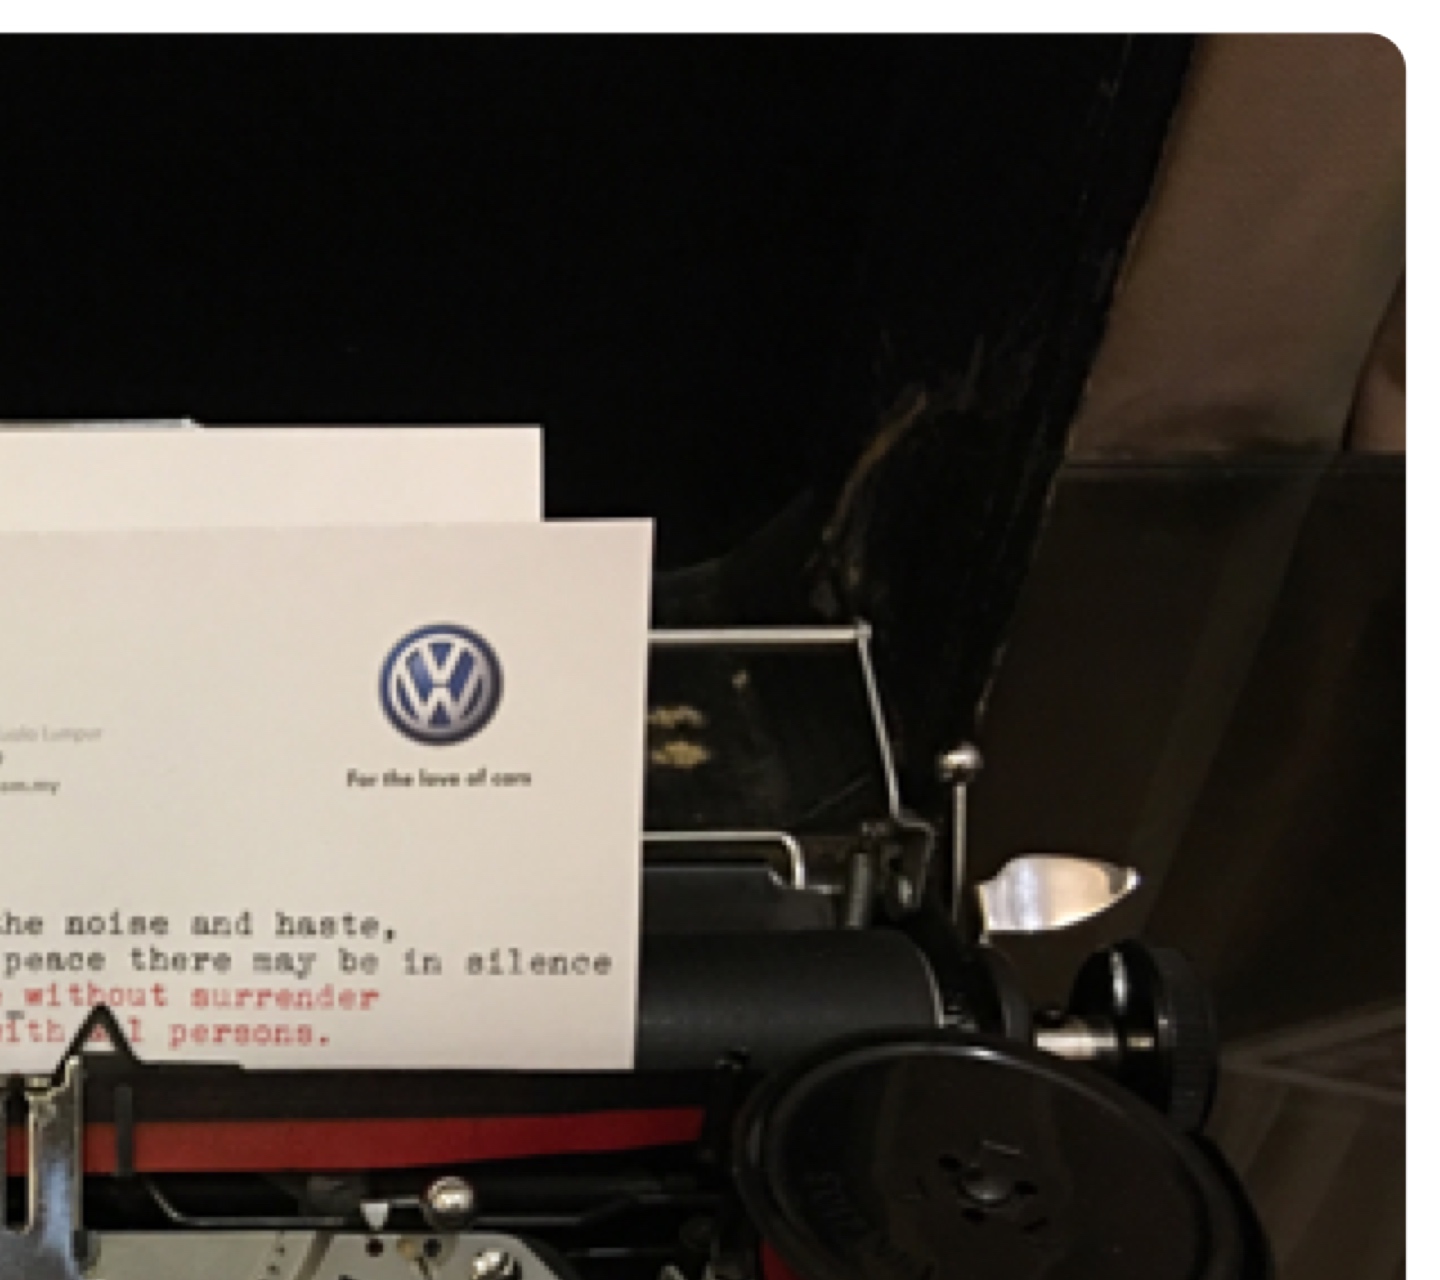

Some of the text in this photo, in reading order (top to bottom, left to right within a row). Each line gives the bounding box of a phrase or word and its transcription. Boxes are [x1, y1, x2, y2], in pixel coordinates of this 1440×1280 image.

[347, 767, 531, 787] For the love of cars
[64, 909, 169, 936] noise
[190, 911, 253, 936] and
[274, 911, 396, 942] haste,
[2, 951, 107, 979] peace
[129, 947, 232, 974] there
[252, 951, 317, 979] may
[338, 948, 378, 974] be
[404, 948, 442, 974] in
[464, 947, 612, 975] silence
[22, 982, 169, 1008] without
[190, 983, 380, 1010] surrender
[169, 1022, 331, 1050] persons.
